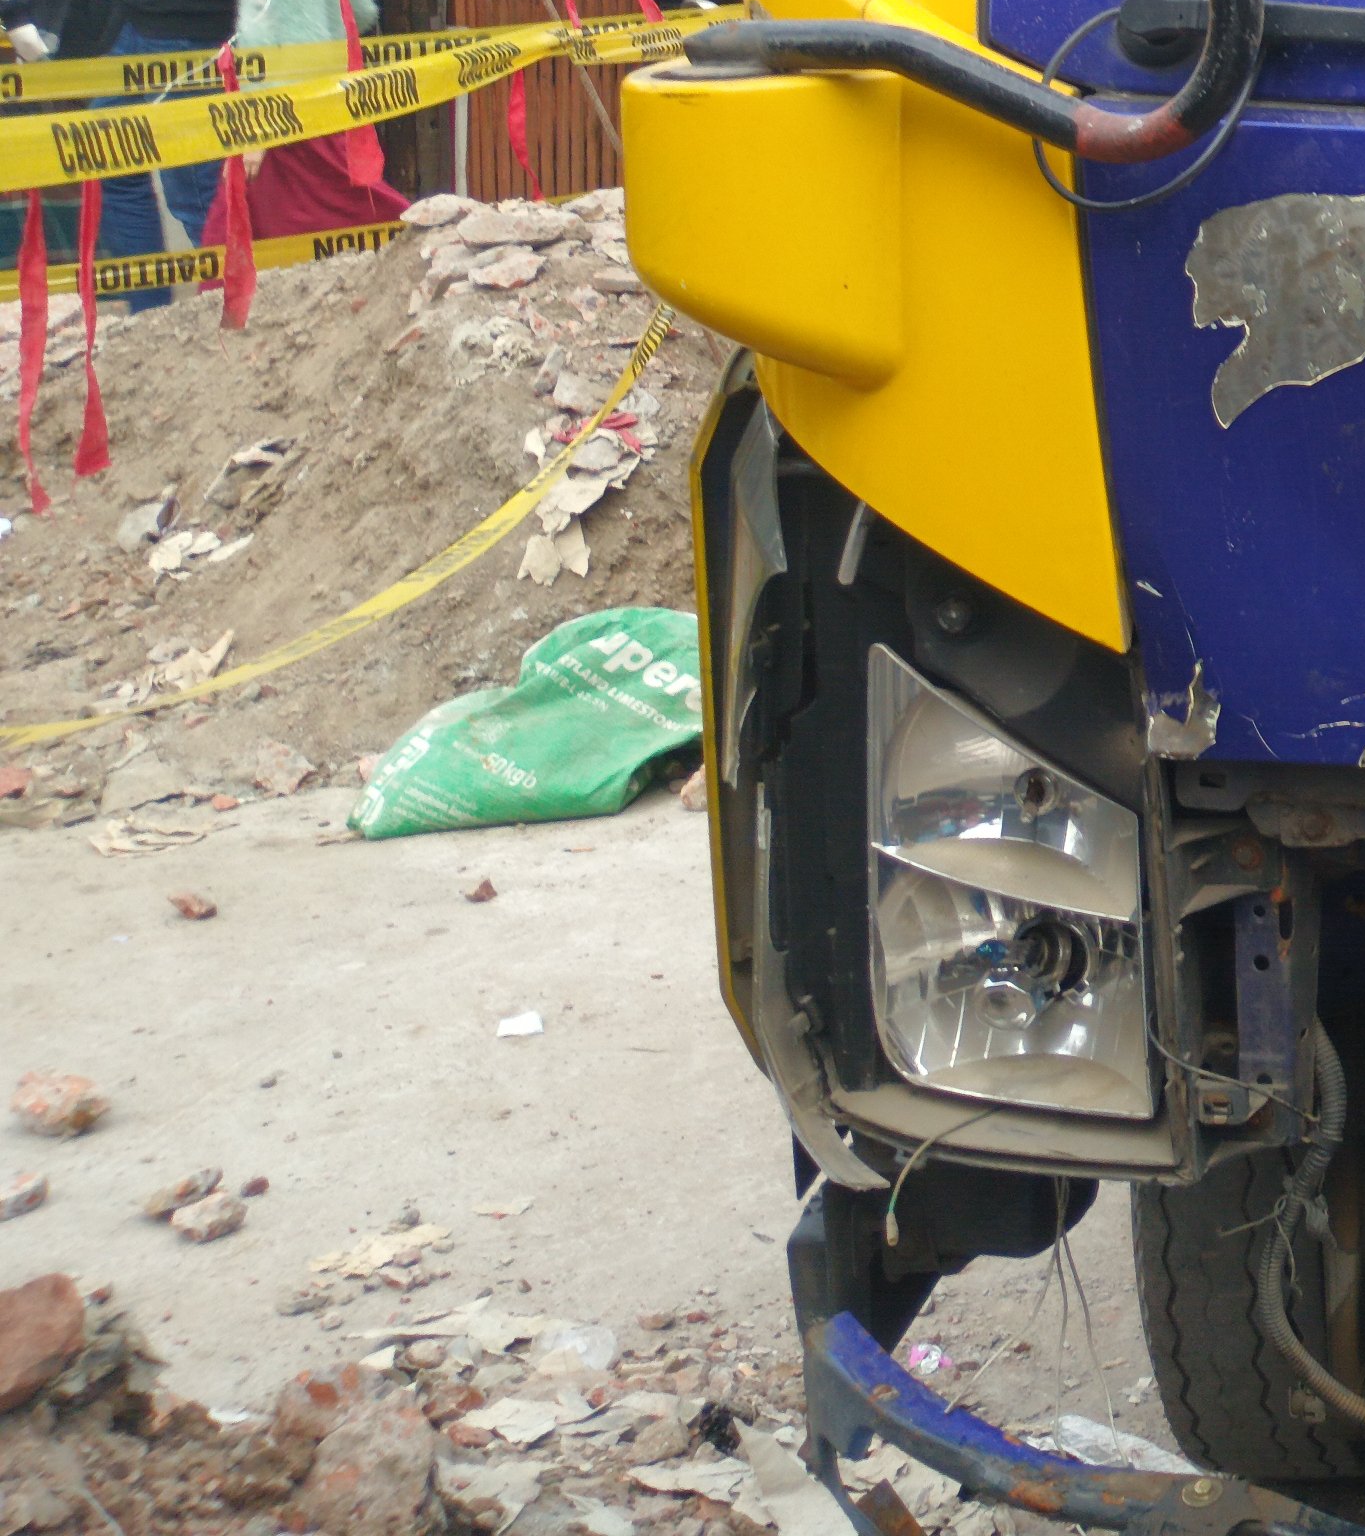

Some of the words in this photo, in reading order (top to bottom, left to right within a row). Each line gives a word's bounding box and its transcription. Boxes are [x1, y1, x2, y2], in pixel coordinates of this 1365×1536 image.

[51, 114, 162, 178] CAUTION
[208, 93, 304, 150] CAUTION
[343, 66, 420, 121] CAUTION
